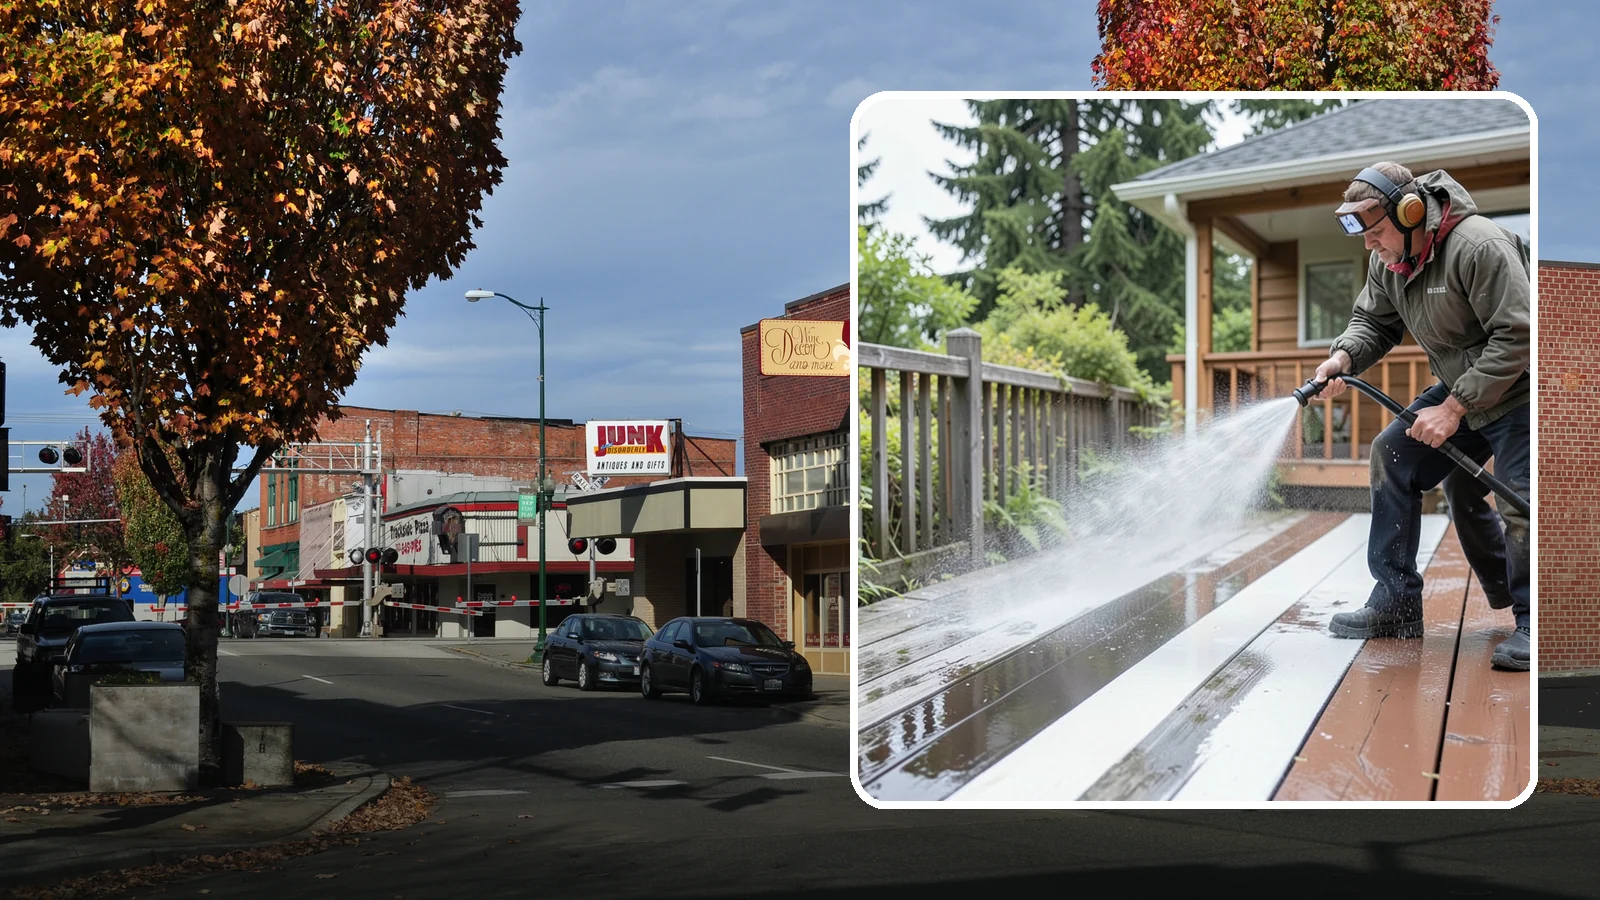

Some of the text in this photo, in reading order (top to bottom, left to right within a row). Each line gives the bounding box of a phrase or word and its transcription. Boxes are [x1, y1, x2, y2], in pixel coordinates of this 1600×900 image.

[765, 328, 830, 365] Decor
[595, 425, 665, 457] JUNK
[607, 446, 646, 454] DISORDERLY
[597, 460, 665, 470] ANTIQUES AND GIFTS
[352, 498, 364, 510] CRO
[414, 519, 429, 534] Pizza
